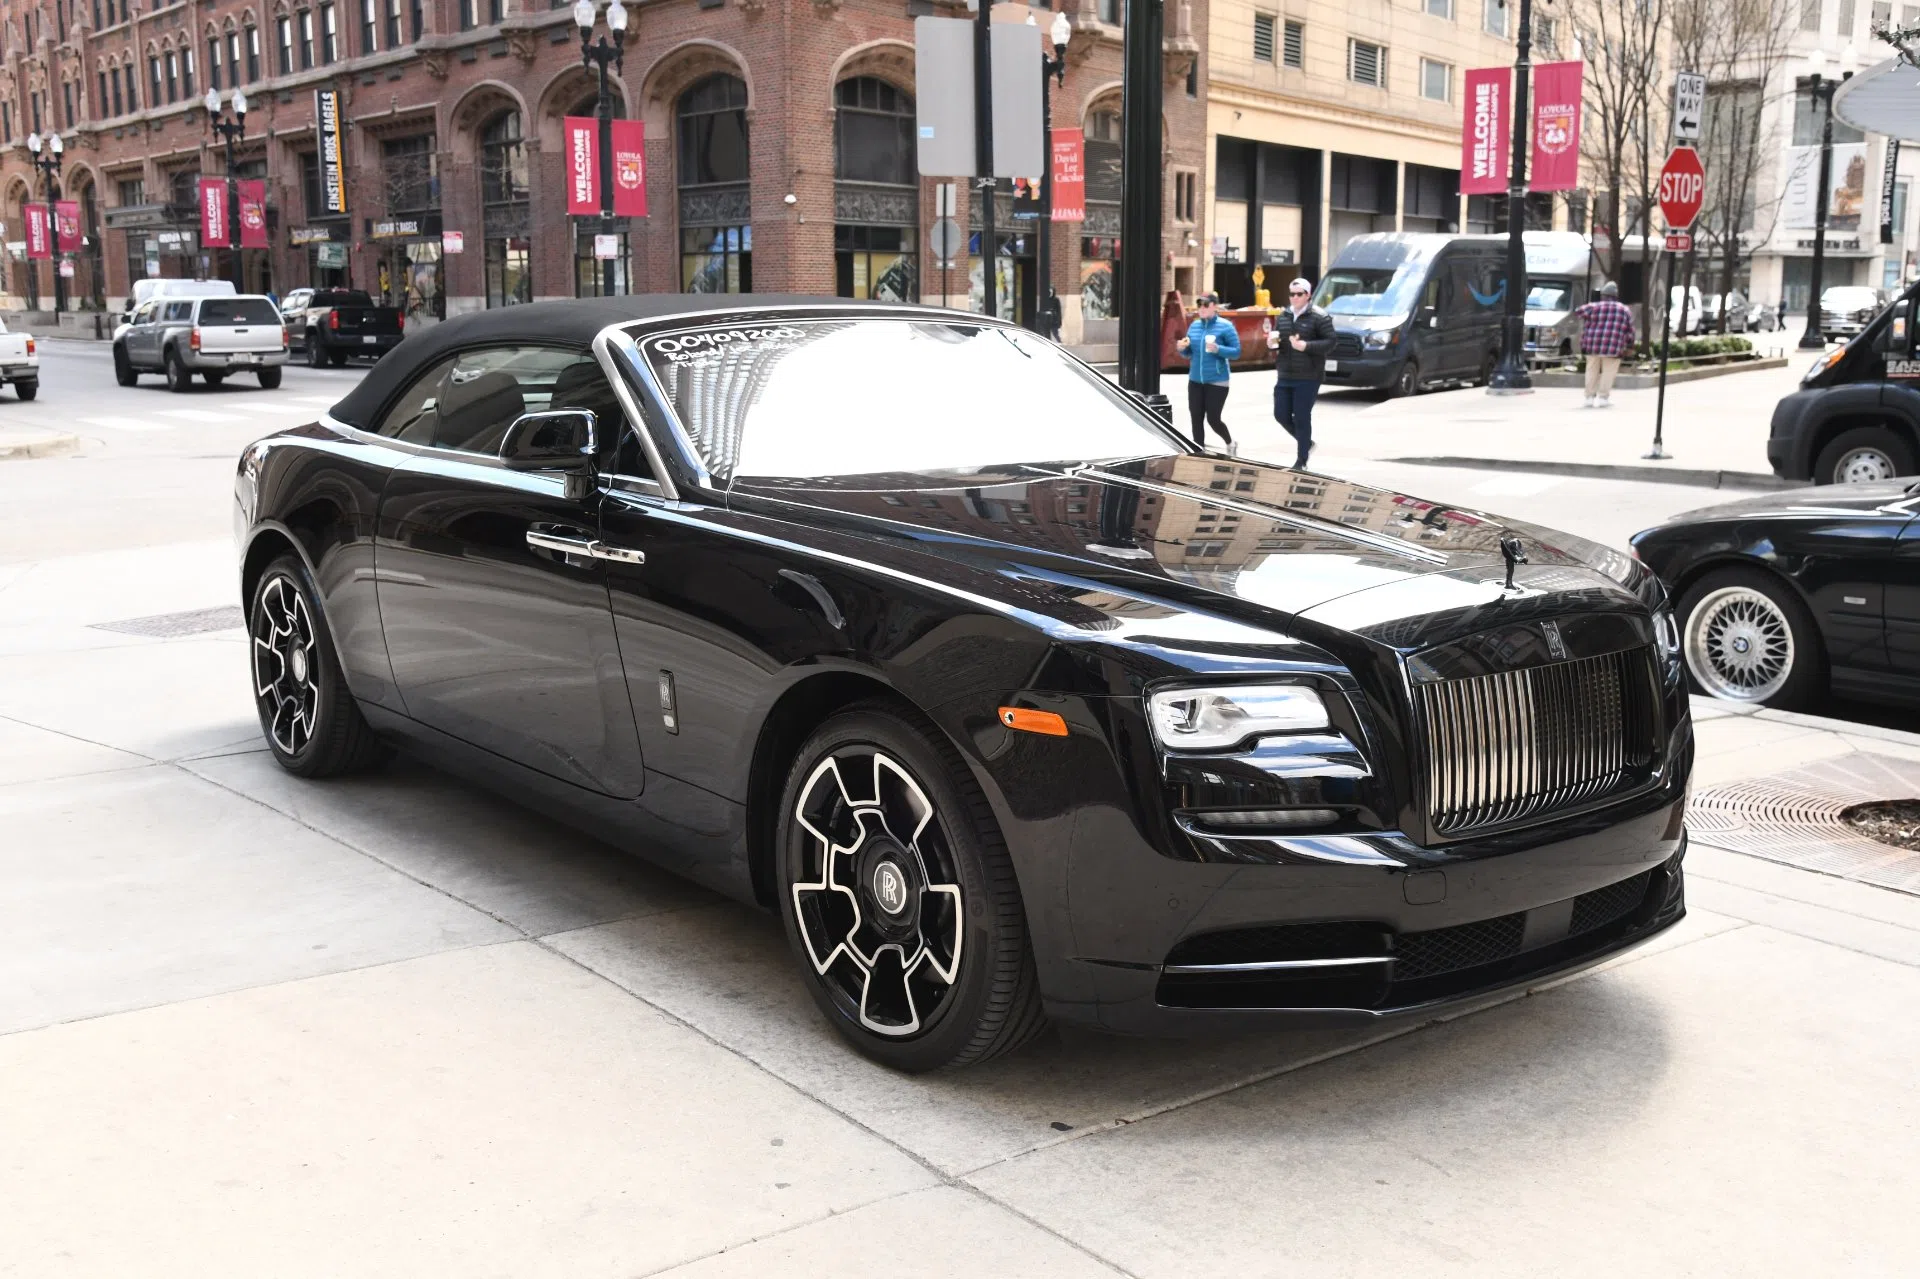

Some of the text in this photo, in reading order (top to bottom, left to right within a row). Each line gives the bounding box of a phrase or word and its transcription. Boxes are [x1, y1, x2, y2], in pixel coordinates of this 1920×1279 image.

[1680, 78, 1701, 95] ONE
[322, 92, 336, 132] BAGELS
[1539, 104, 1575, 115] LOYOLA
[1679, 99, 1700, 112] WAY
[1473, 83, 1490, 178] WELCOME
[1488, 83, 1499, 178] WATER TOWER CAMPUS
[573, 129, 587, 203] WELCOME
[1055, 153, 1078, 163] David
[326, 164, 340, 211] EINSTEIN
[1661, 172, 1702, 204] STOP
[206, 187, 218, 239] WELCOME
[1667, 237, 1677, 248] ALL
[1678, 237, 1689, 248] WAY
